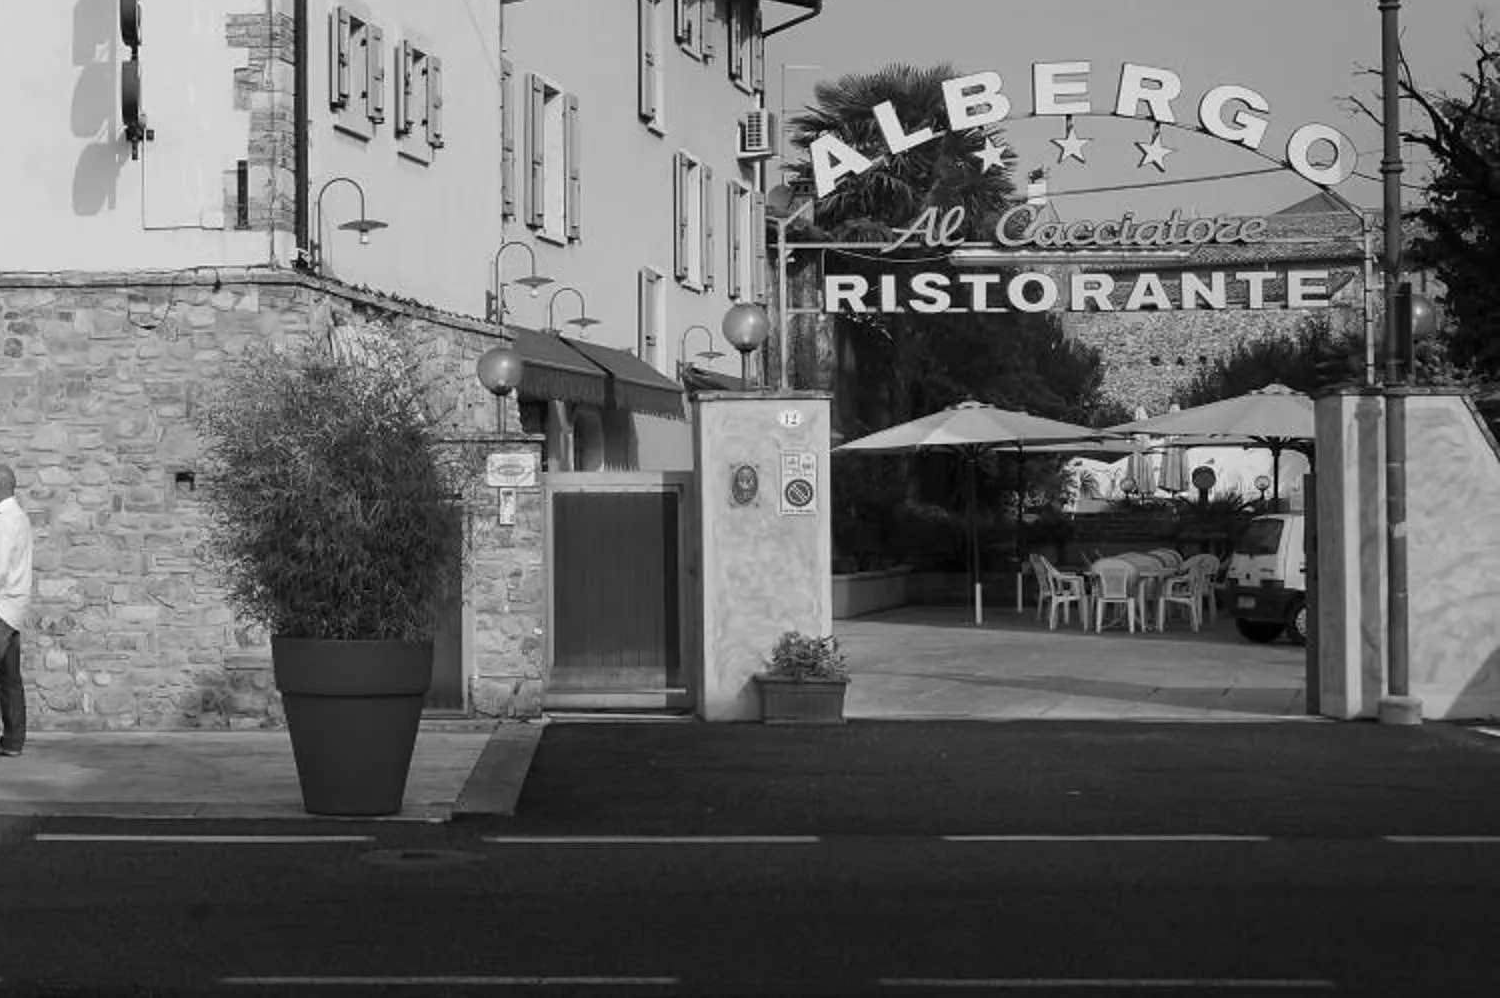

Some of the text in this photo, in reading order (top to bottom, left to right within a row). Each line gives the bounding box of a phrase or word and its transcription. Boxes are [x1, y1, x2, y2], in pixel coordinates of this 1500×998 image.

[810, 60, 1359, 199] ALBERGO
[880, 204, 1269, 254] Al Cacciatore
[824, 269, 1331, 314] RISTORANTE
